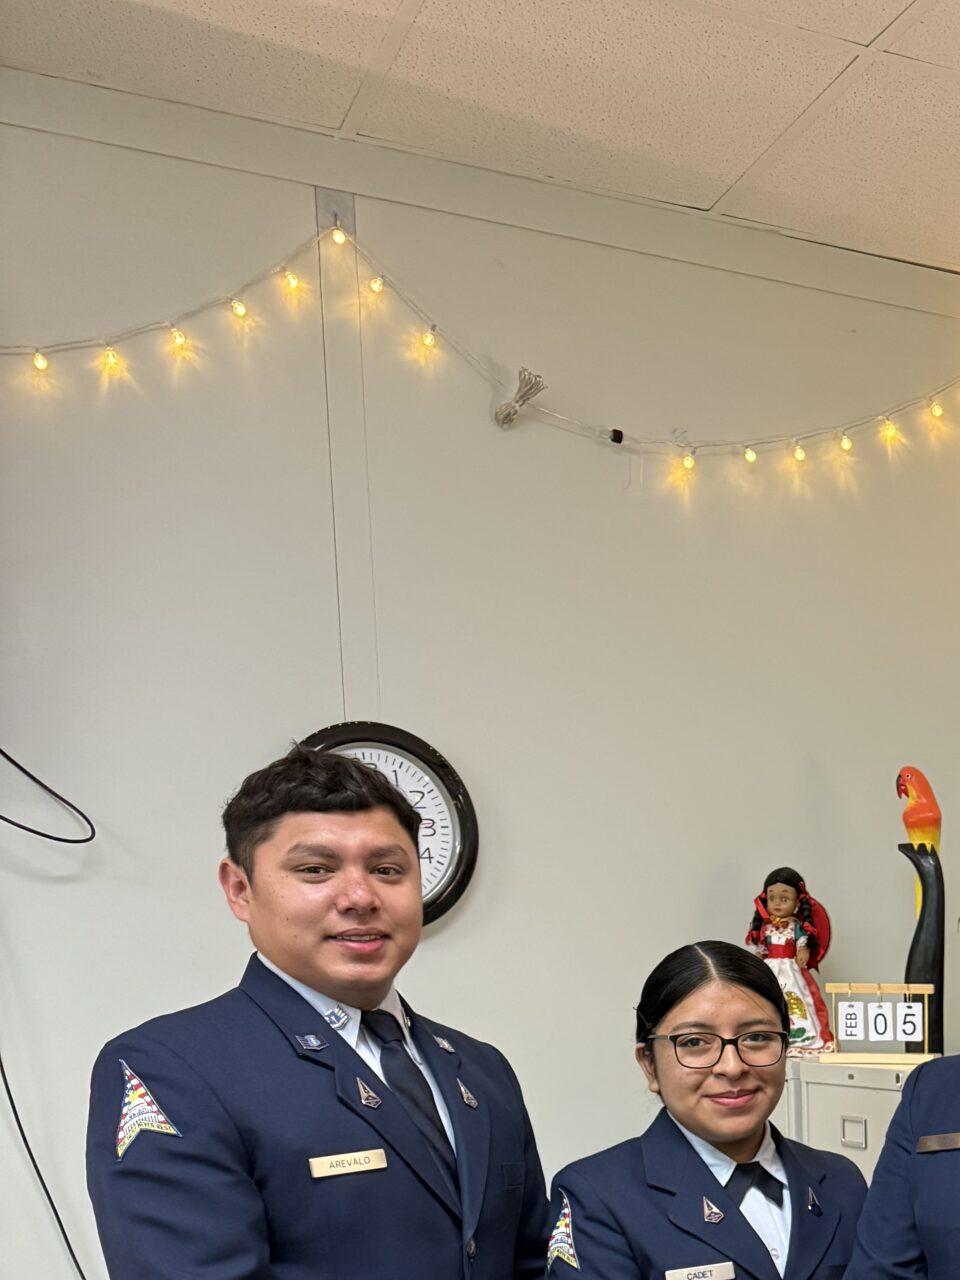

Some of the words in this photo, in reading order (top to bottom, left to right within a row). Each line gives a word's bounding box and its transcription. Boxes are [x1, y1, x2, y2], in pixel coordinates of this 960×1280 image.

[421, 818, 437, 837] 3
[419, 847, 435, 864] 4
[845, 1012, 858, 1038] FEB
[329, 1156, 371, 1169] AREVALO
[686, 1269, 714, 1280] CADET
